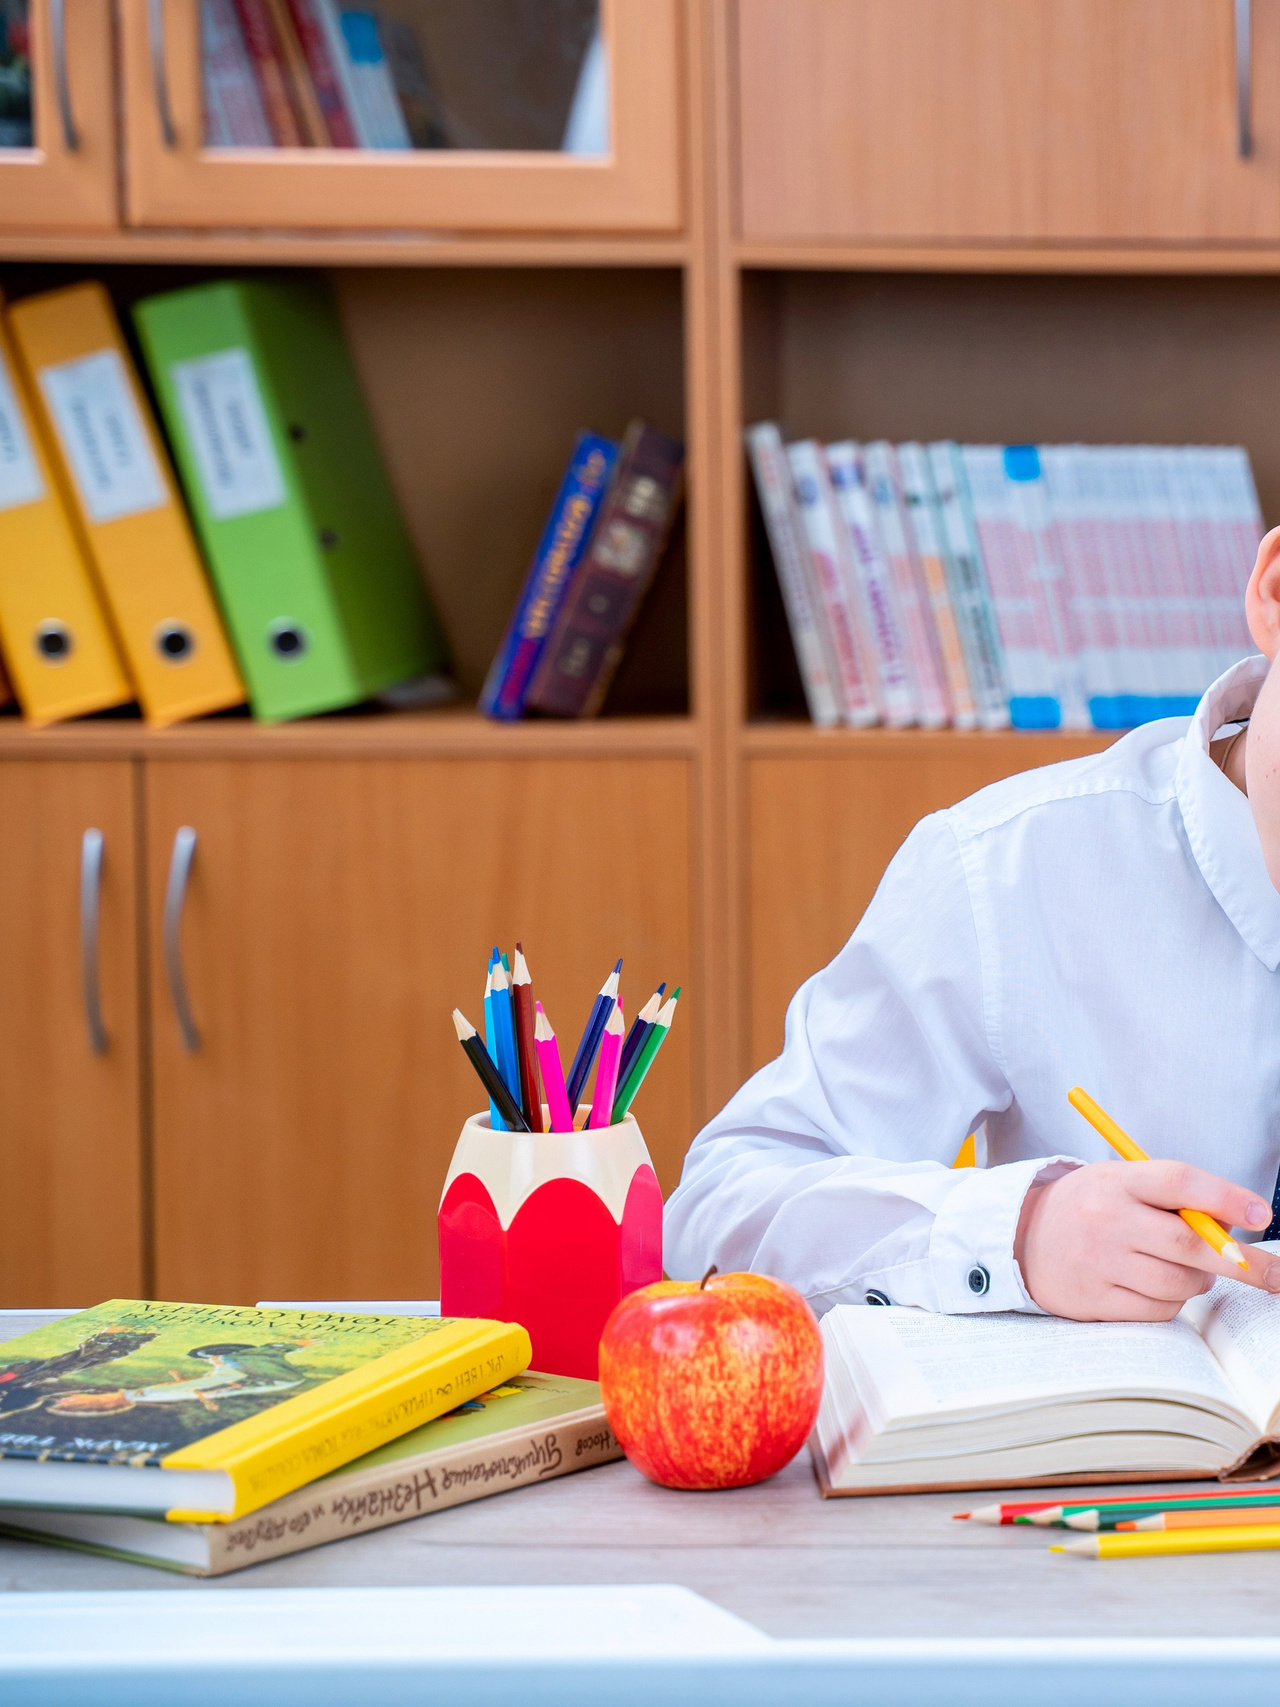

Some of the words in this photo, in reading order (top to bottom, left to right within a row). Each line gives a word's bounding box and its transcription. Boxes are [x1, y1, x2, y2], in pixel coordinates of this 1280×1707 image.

[121, 1312, 382, 1334] ПРИКЛЮЧЕНИЯ
[300, 1313, 397, 1327] ТОМА
[575, 1430, 610, 1456] Носов
[442, 1434, 562, 1490] Приключения
[331, 1468, 438, 1525] Незнайки
